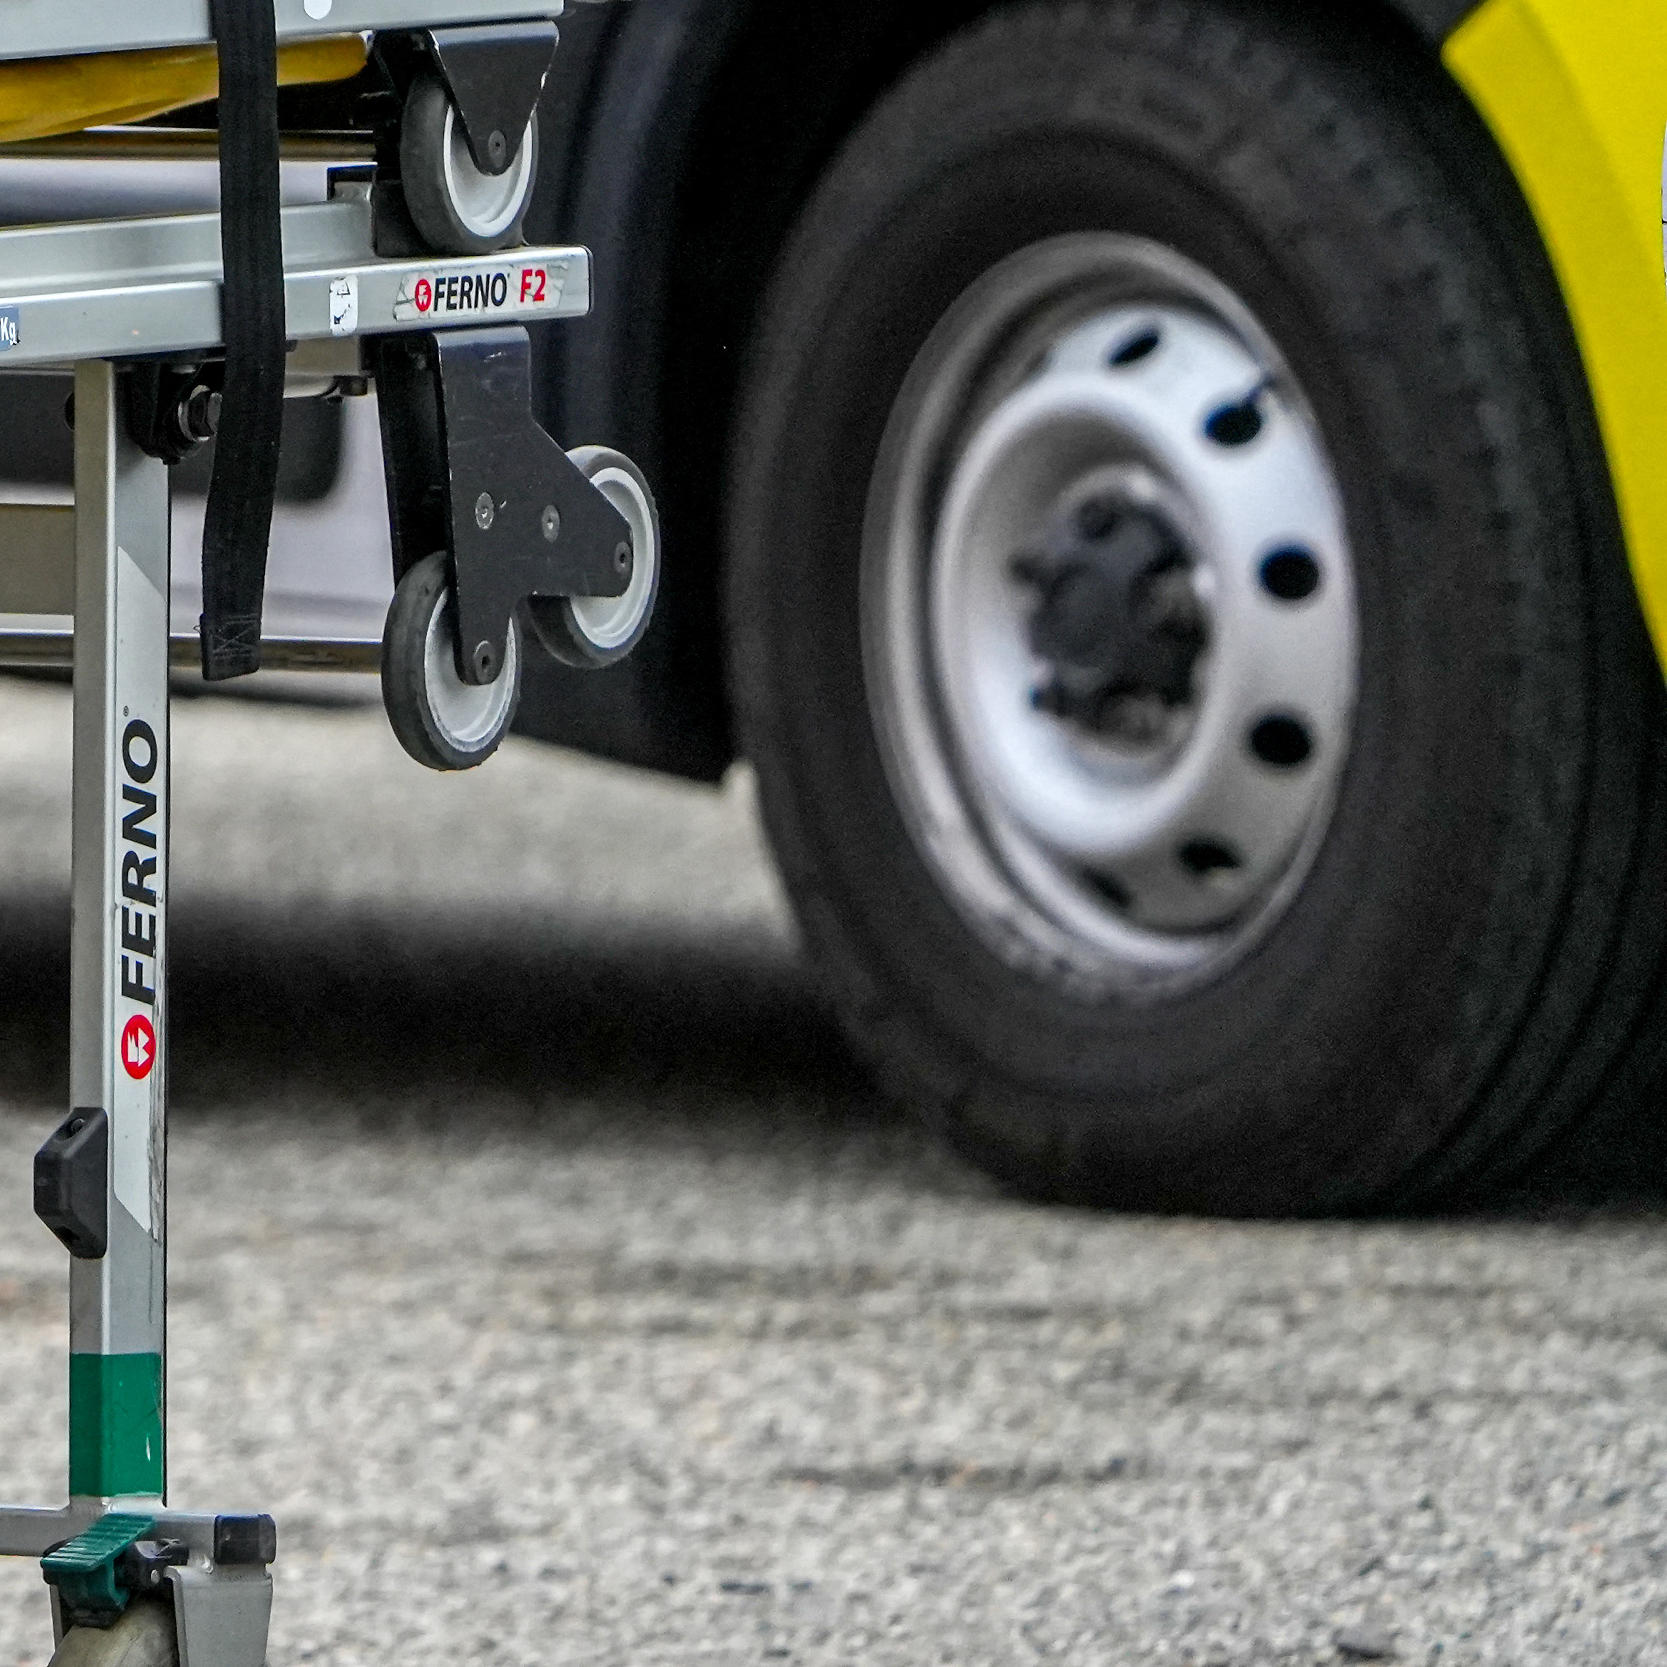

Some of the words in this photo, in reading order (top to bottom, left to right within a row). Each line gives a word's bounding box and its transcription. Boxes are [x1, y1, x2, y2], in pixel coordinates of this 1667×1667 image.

[433, 272, 508, 312] FERNO
[520, 268, 546, 303] F2
[121, 718, 159, 1006] FERNO
